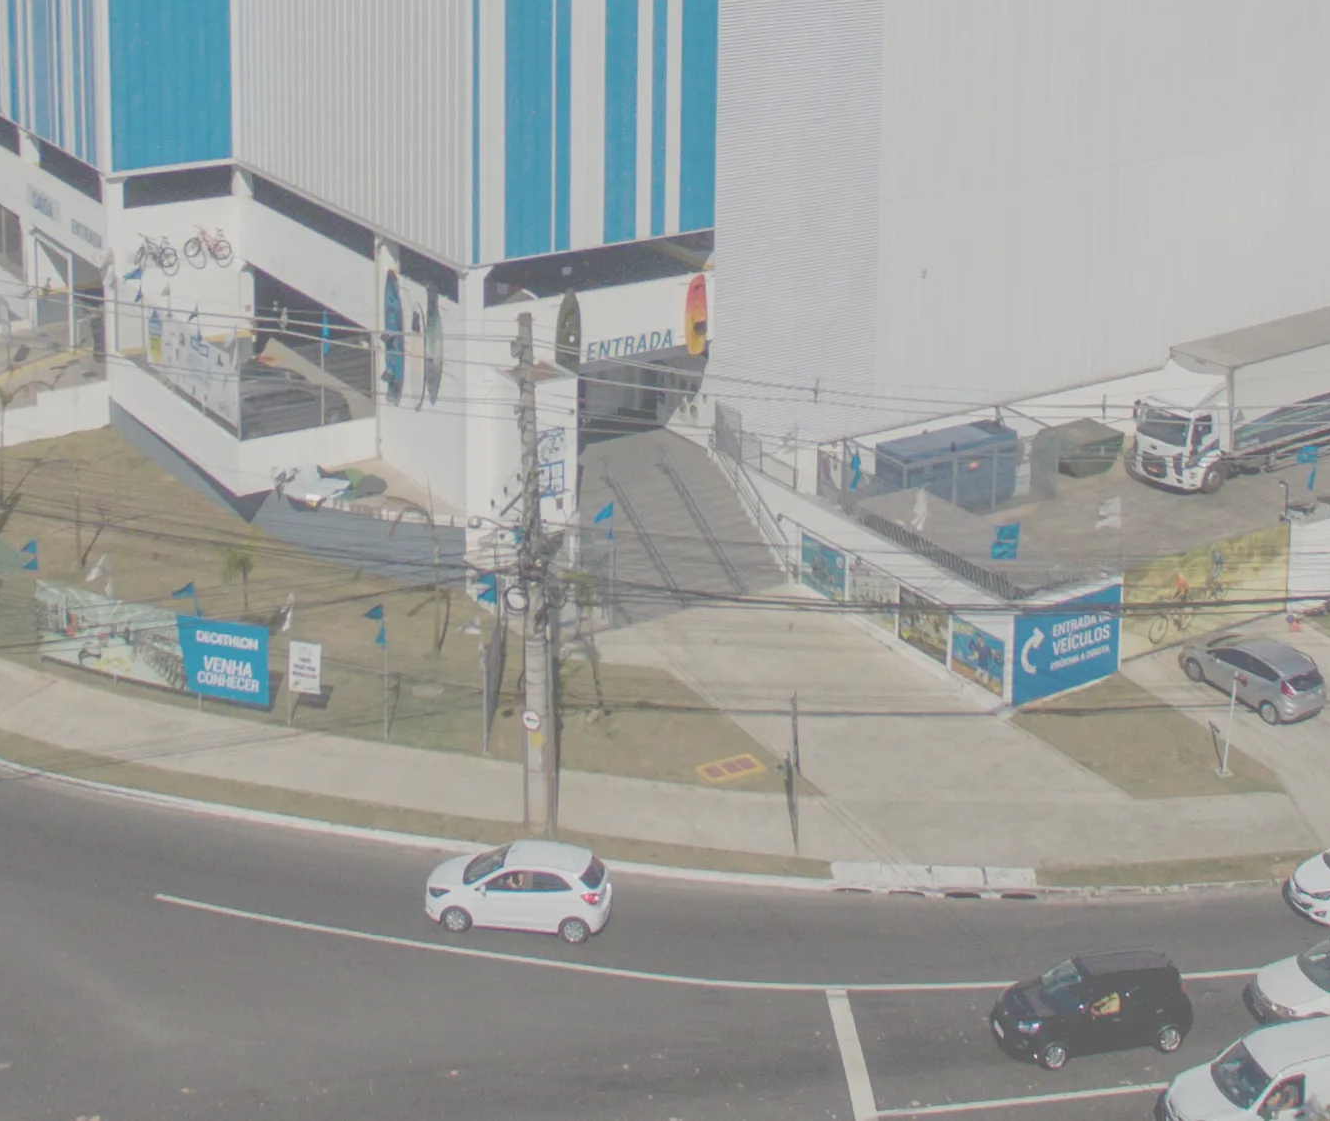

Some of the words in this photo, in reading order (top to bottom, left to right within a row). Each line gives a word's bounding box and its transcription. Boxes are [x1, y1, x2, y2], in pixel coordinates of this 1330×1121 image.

[587, 328, 674, 360] ENTRADA
[1052, 615, 1098, 638] ENTRADA
[195, 629, 259, 652] DECATHLON
[1052, 624, 1112, 656] VEÍCULOS
[203, 654, 253, 678] VENHA
[197, 670, 260, 693] CONHECER
